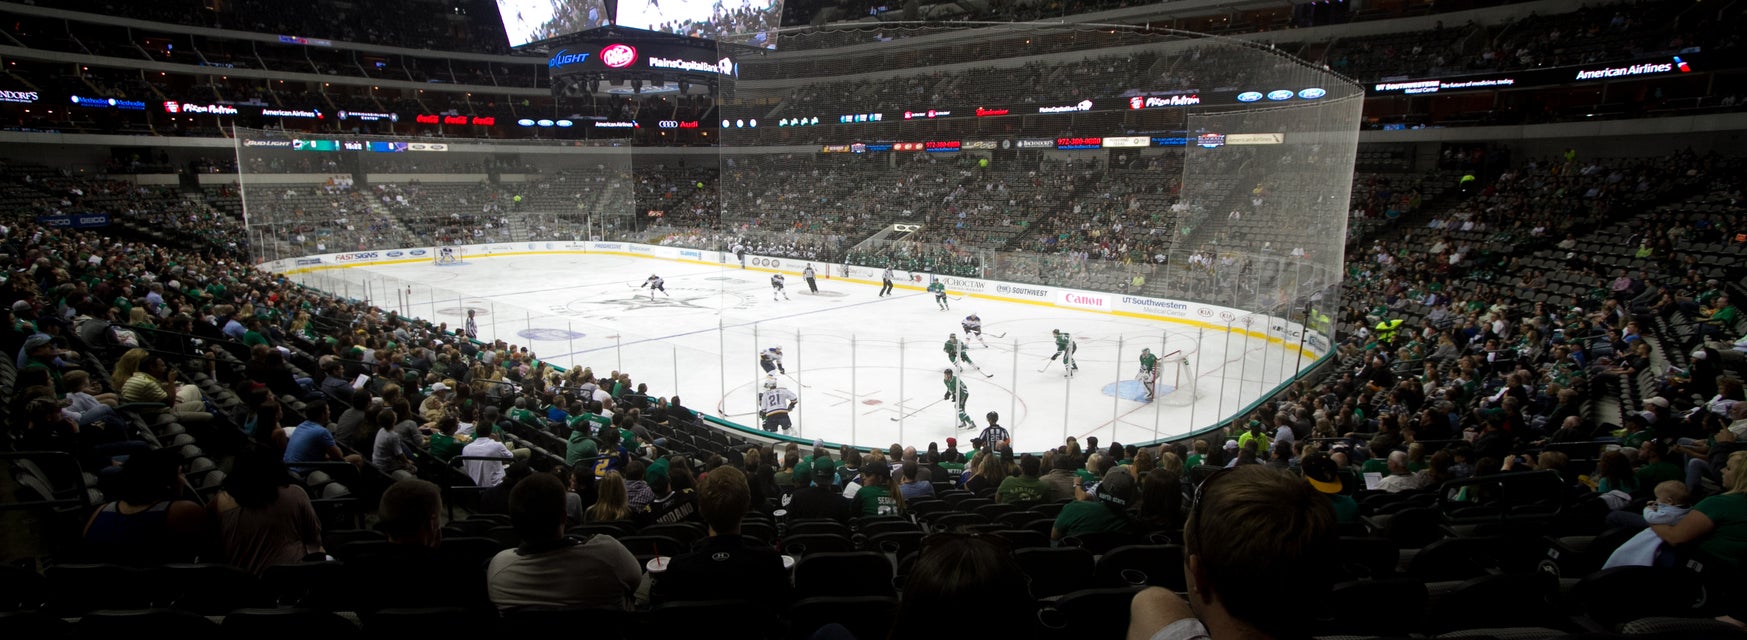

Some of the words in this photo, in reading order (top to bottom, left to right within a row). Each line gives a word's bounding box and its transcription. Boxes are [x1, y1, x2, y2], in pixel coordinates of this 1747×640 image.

[558, 53, 590, 64] LIGHT
[1576, 67, 1627, 80] American
[1627, 63, 1672, 75] Airlines
[336, 252, 378, 261] FASTSIGNS
[948, 278, 985, 289] CHOCTAW
[1012, 287, 1048, 296] SOUTHWEST
[1065, 293, 1103, 306] Canon
[1132, 298, 1187, 310] Southwestern
[769, 394, 780, 406] 21
